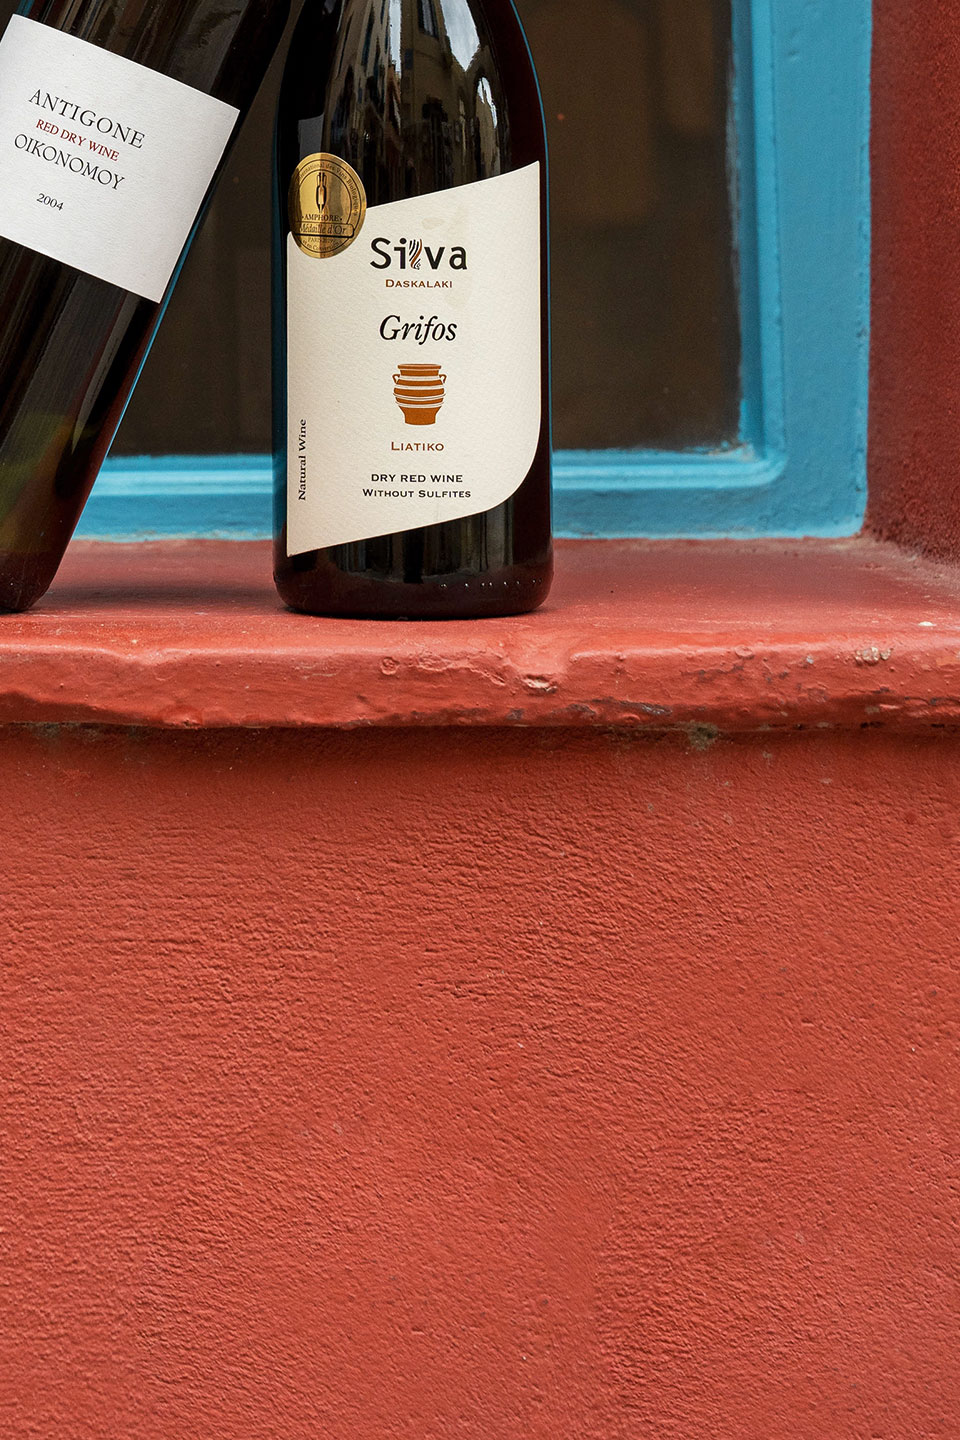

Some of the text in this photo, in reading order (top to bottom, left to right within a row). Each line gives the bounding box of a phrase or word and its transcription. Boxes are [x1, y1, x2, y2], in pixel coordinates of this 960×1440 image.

[28, 88, 145, 149] ANTIGONE
[36, 118, 120, 162] RED DRY WINE
[14, 133, 125, 191] OIKONOMOY
[36, 192, 64, 212] 2004
[303, 214, 339, 222] AMPHORE
[379, 314, 458, 346] Grifos
[297, 418, 307, 501] Natural Wine
[371, 473, 463, 483] DRY RED WINE
